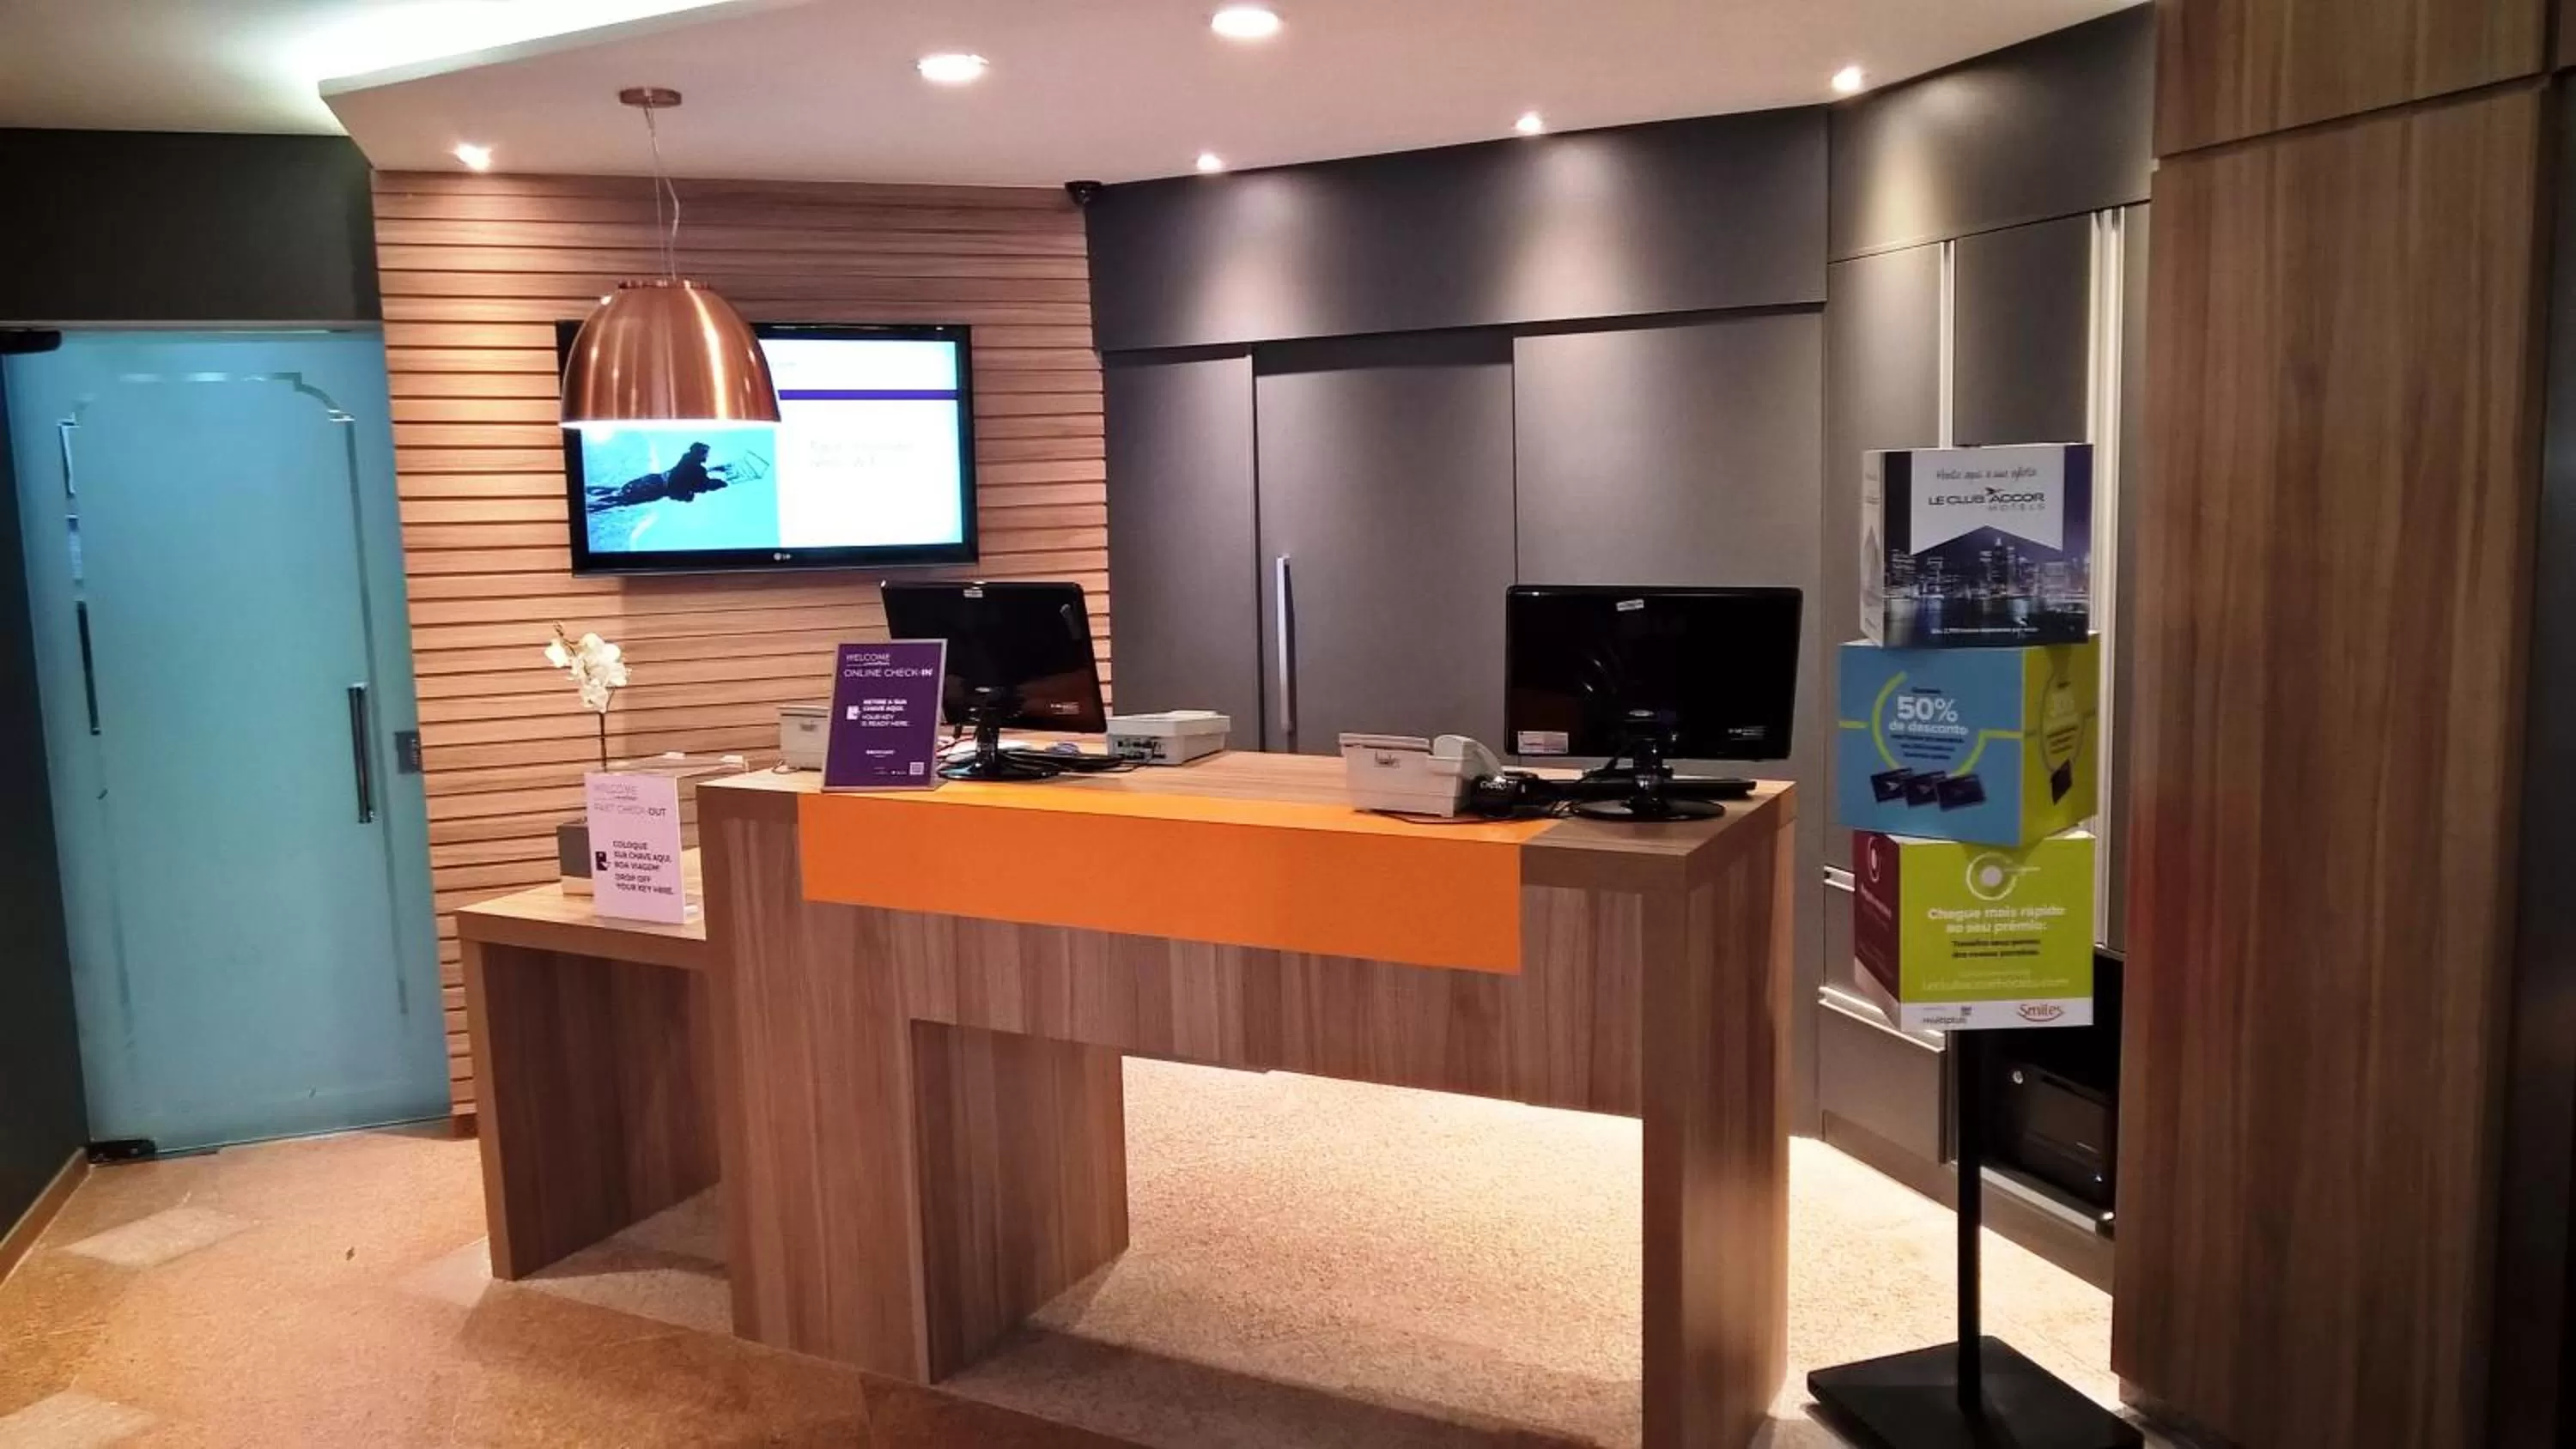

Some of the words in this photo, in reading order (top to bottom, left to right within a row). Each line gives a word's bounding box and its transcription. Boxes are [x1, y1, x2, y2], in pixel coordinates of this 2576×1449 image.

[1928, 495, 1944, 506] LE
[1946, 494, 1984, 505] CLUB
[1988, 492, 2045, 503] ACCOR
[846, 653, 890, 662] WELCOME
[844, 669, 883, 677] ONLINE
[1897, 695, 1959, 723] 50%
[1888, 719, 1905, 732] de
[1907, 721, 1970, 736] desconto
[612, 840, 647, 851] COLOQUE
[1928, 907, 1981, 922] Chegue
[1984, 906, 2017, 918] mais
[1945, 923, 1964, 934] ao
[1965, 922, 1991, 933] seu
[2018, 1003, 2063, 1019] Smiles
